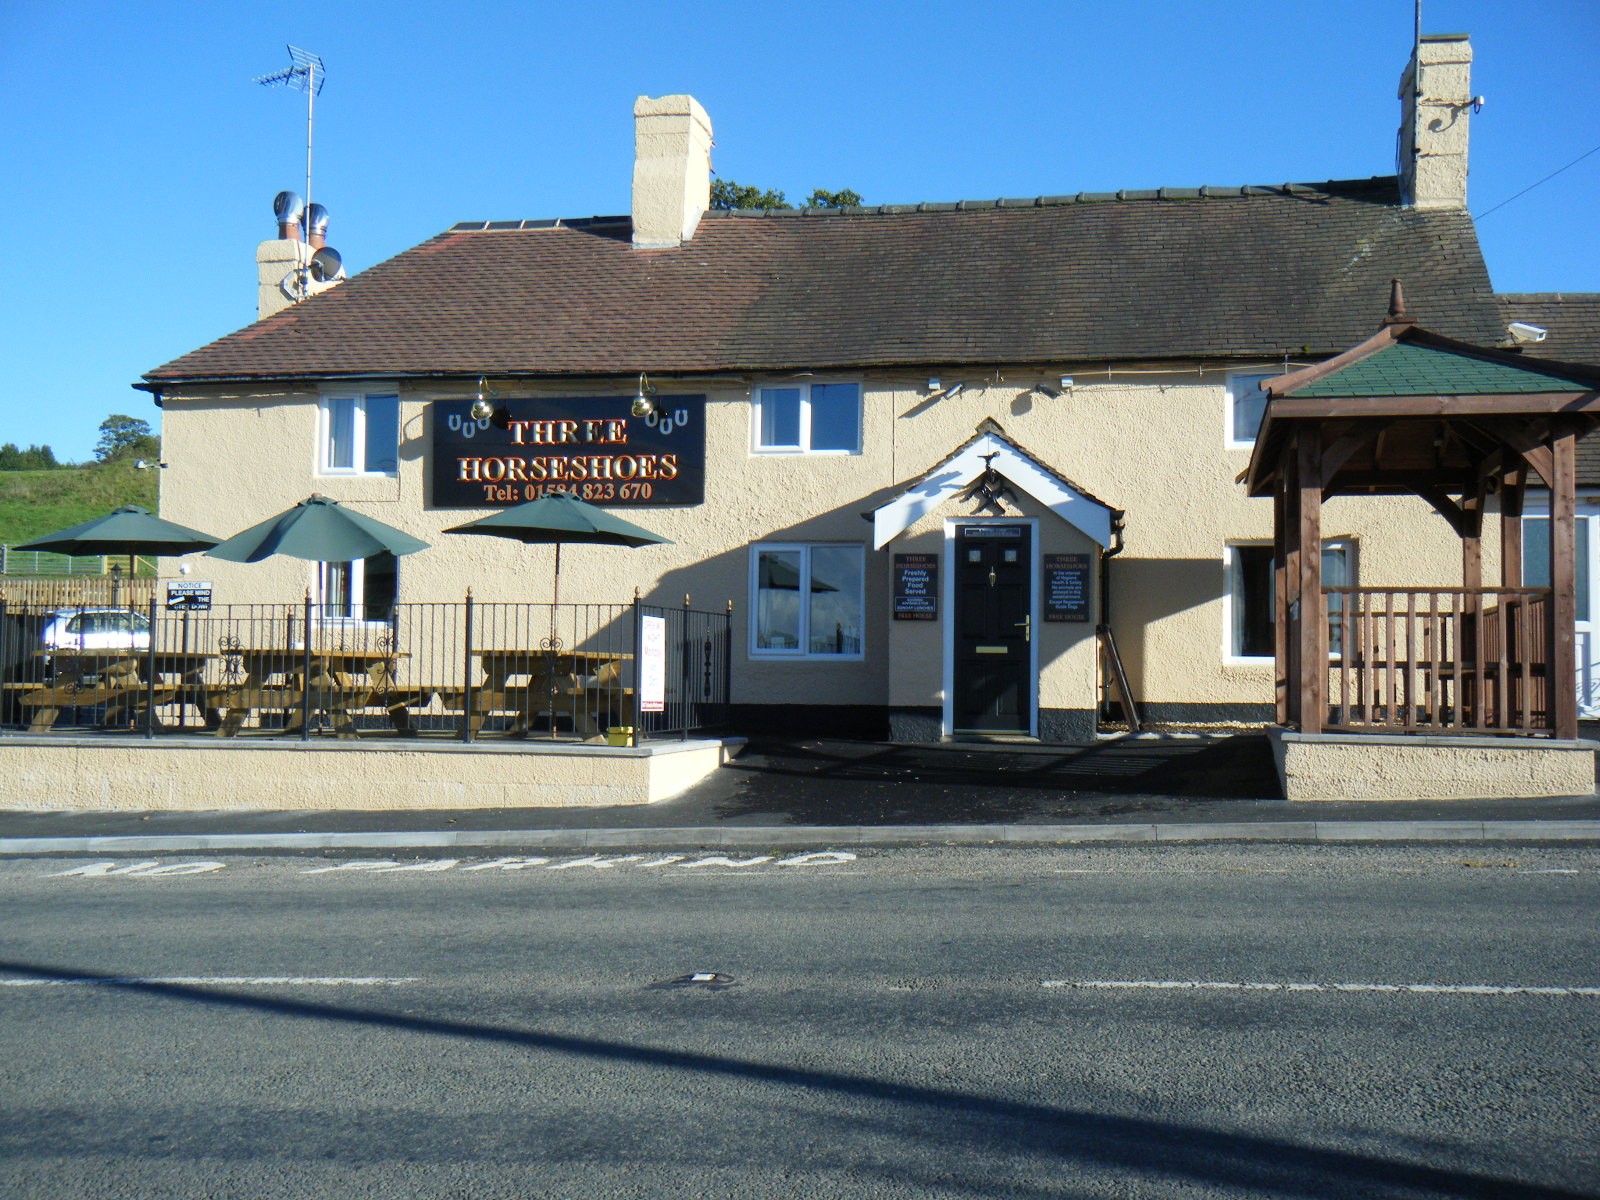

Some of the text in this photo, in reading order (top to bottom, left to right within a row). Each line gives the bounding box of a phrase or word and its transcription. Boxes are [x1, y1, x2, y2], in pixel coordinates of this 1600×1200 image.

[508, 418, 628, 446] THREE
[456, 454, 678, 482] HORSESHOES
[483, 484, 519, 502] Tel:
[583, 483, 615, 500] 823
[619, 482, 652, 499] 670
[904, 569, 927, 577] Freshly
[45, 861, 226, 877] NO
[300, 851, 857, 875] PARKING
